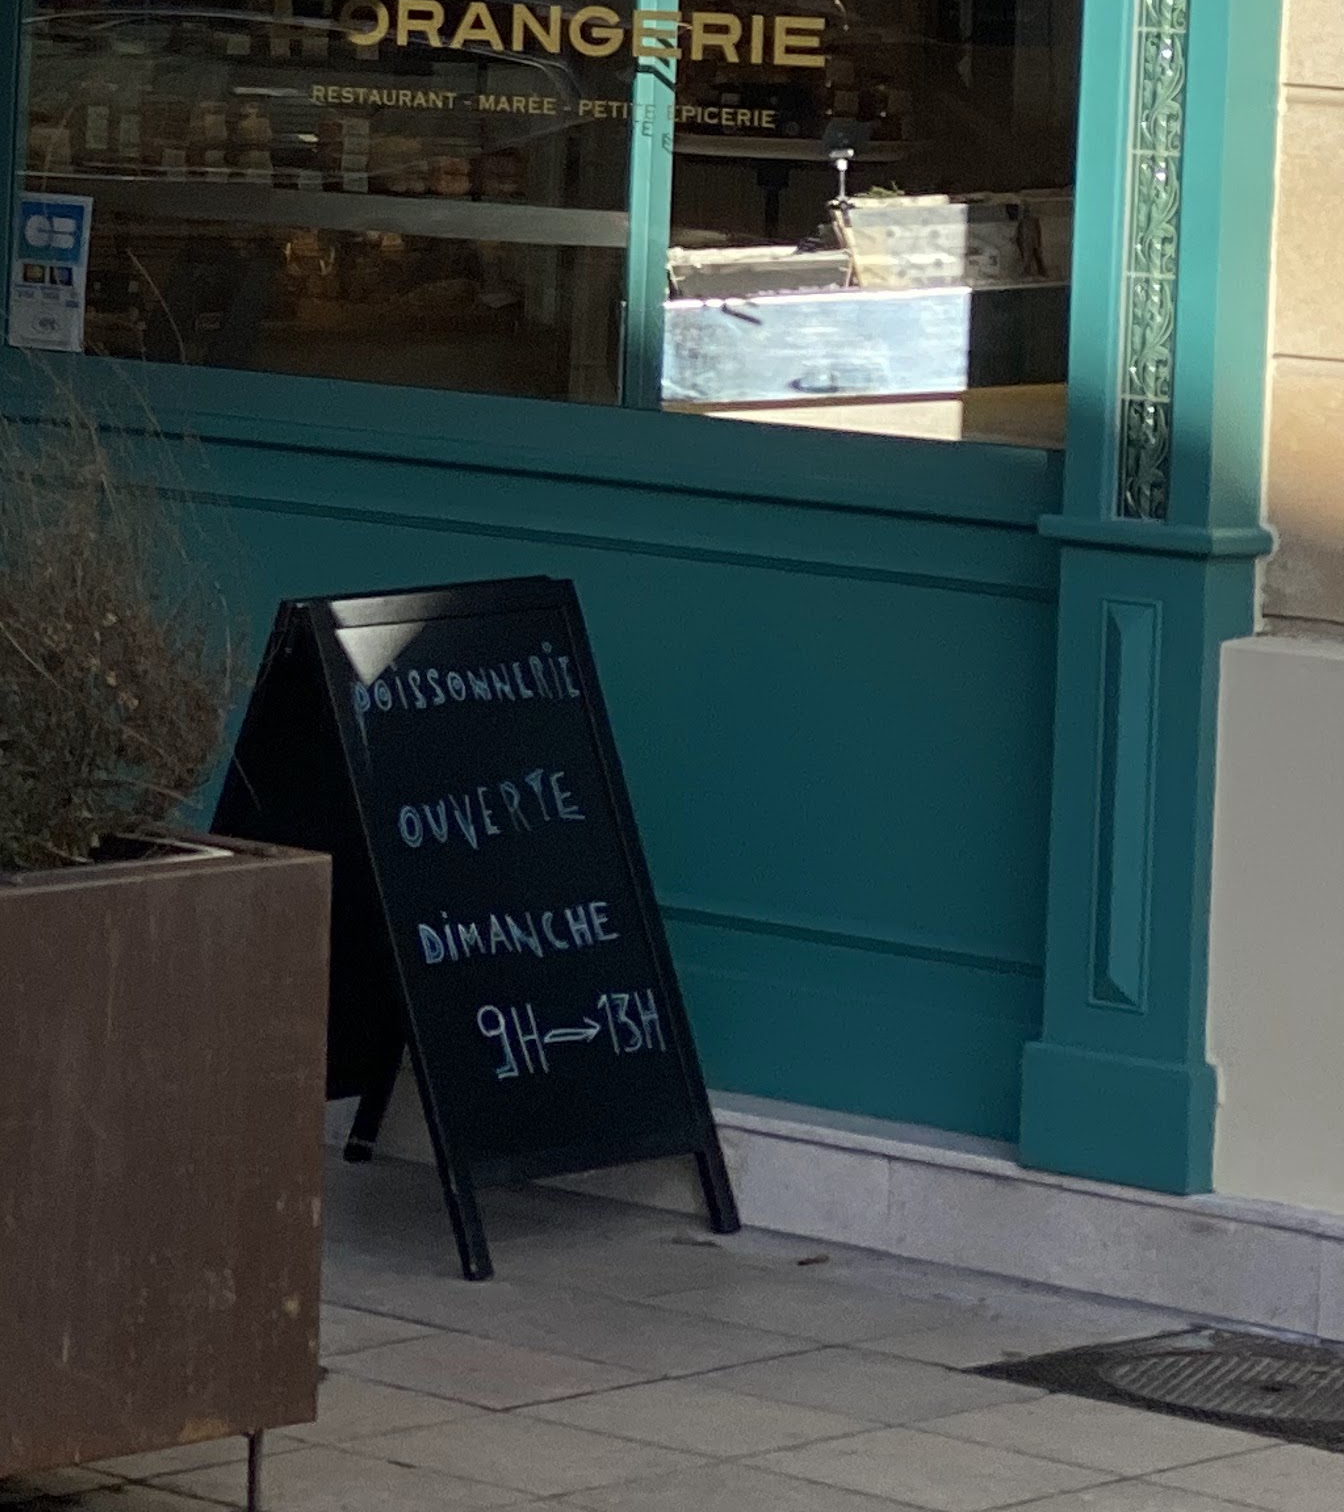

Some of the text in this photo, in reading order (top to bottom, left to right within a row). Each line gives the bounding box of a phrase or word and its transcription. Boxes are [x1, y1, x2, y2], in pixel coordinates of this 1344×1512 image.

[311, 84, 457, 109] RESTAURANT
[397, 768, 586, 851] OUVERTE
[417, 900, 620, 965] DIMANCHE
